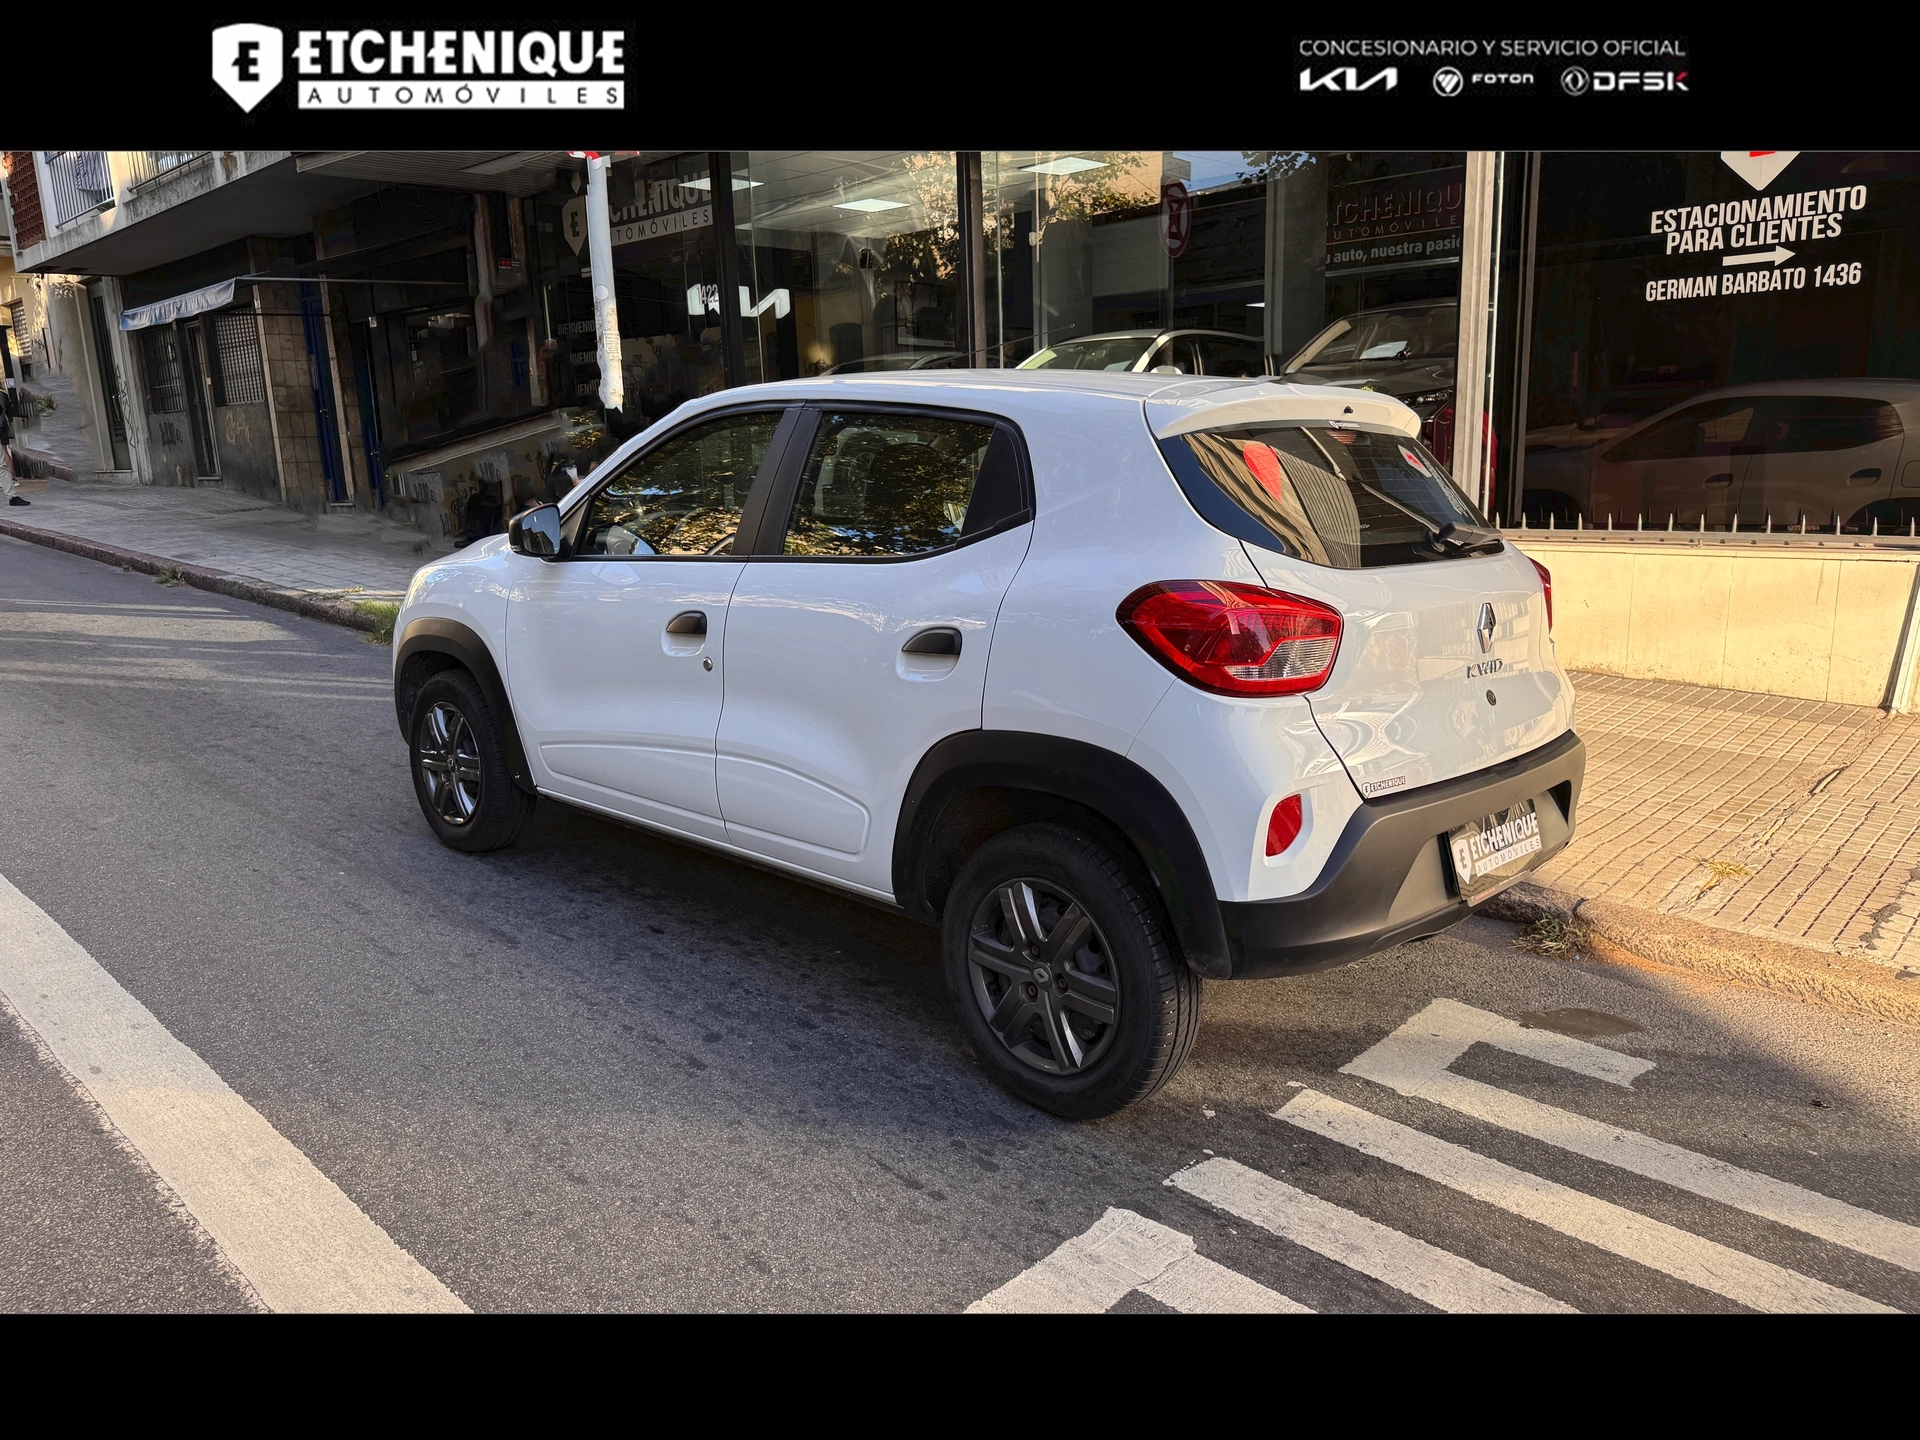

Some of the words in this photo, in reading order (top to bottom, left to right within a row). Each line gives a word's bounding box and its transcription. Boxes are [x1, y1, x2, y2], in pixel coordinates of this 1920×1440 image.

[1650, 185, 1868, 234] ESTACIONAMIENTO
[1666, 226, 1724, 255] PARA
[1730, 212, 1843, 248] CLIENTES
[1370, 241, 1423, 259] nuestra
[1645, 275, 1718, 302] GERMAN
[1721, 266, 1806, 295] BARBATO
[1813, 261, 1862, 287] 1436
[557, 320, 596, 336] BIENVENID
[1466, 658, 1504, 680] KWID
[1370, 775, 1406, 792] ETCHENIQUE
[1469, 811, 1540, 860] ETCHENIQUE
